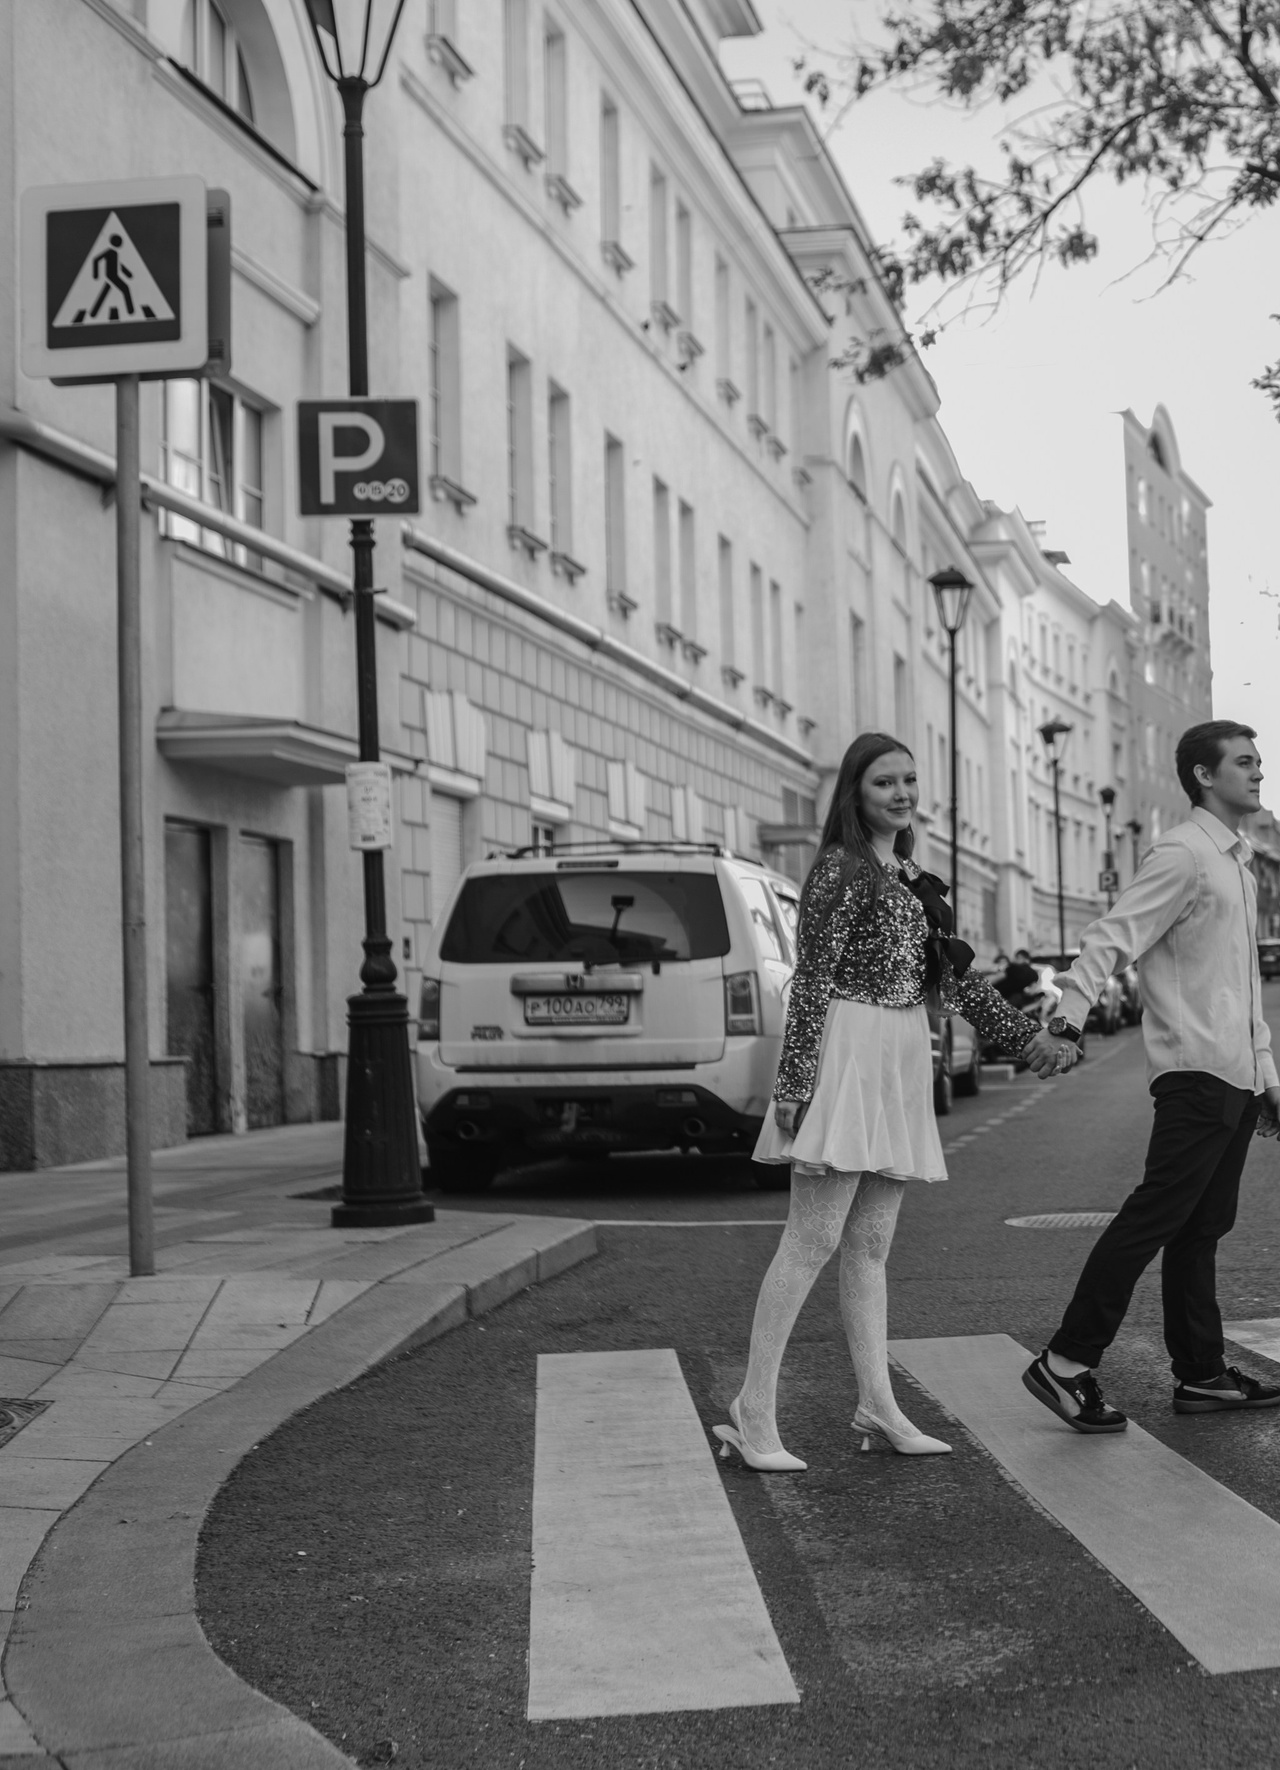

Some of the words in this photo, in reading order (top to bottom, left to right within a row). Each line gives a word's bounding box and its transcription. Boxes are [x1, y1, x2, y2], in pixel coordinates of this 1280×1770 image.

[318, 411, 385, 504] P
[387, 483, 406, 497] 20
[1102, 873, 1113, 889] P
